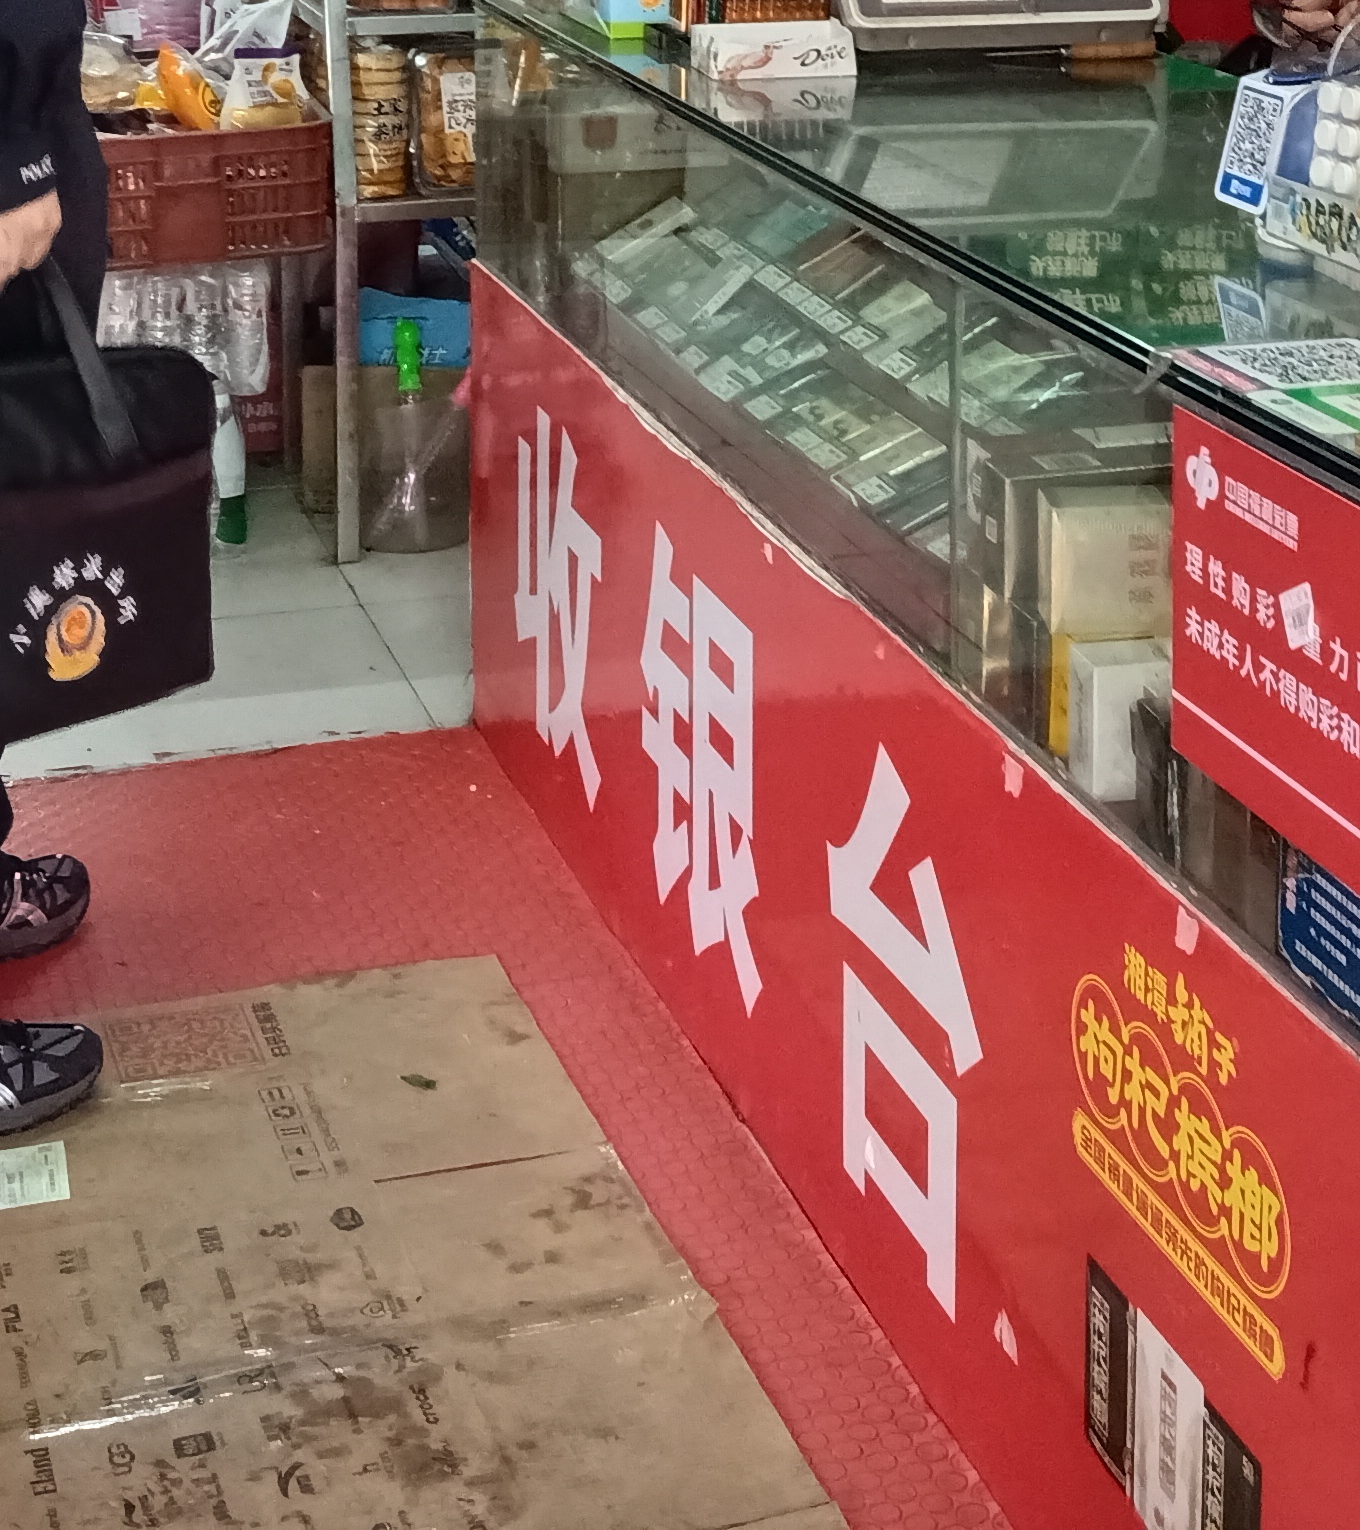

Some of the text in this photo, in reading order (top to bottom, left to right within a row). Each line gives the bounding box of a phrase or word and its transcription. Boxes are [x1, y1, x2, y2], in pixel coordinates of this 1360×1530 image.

[793, 45, 848, 68] Dove
[1225, 475, 1299, 541] 中国福利彩票
[1185, 540, 1276, 630] 理性购彩
[513, 405, 984, 1323] 收银台
[1124, 942, 1238, 1086] 湘潭铺子
[1079, 999, 1281, 1272] 枸杞槟榔
